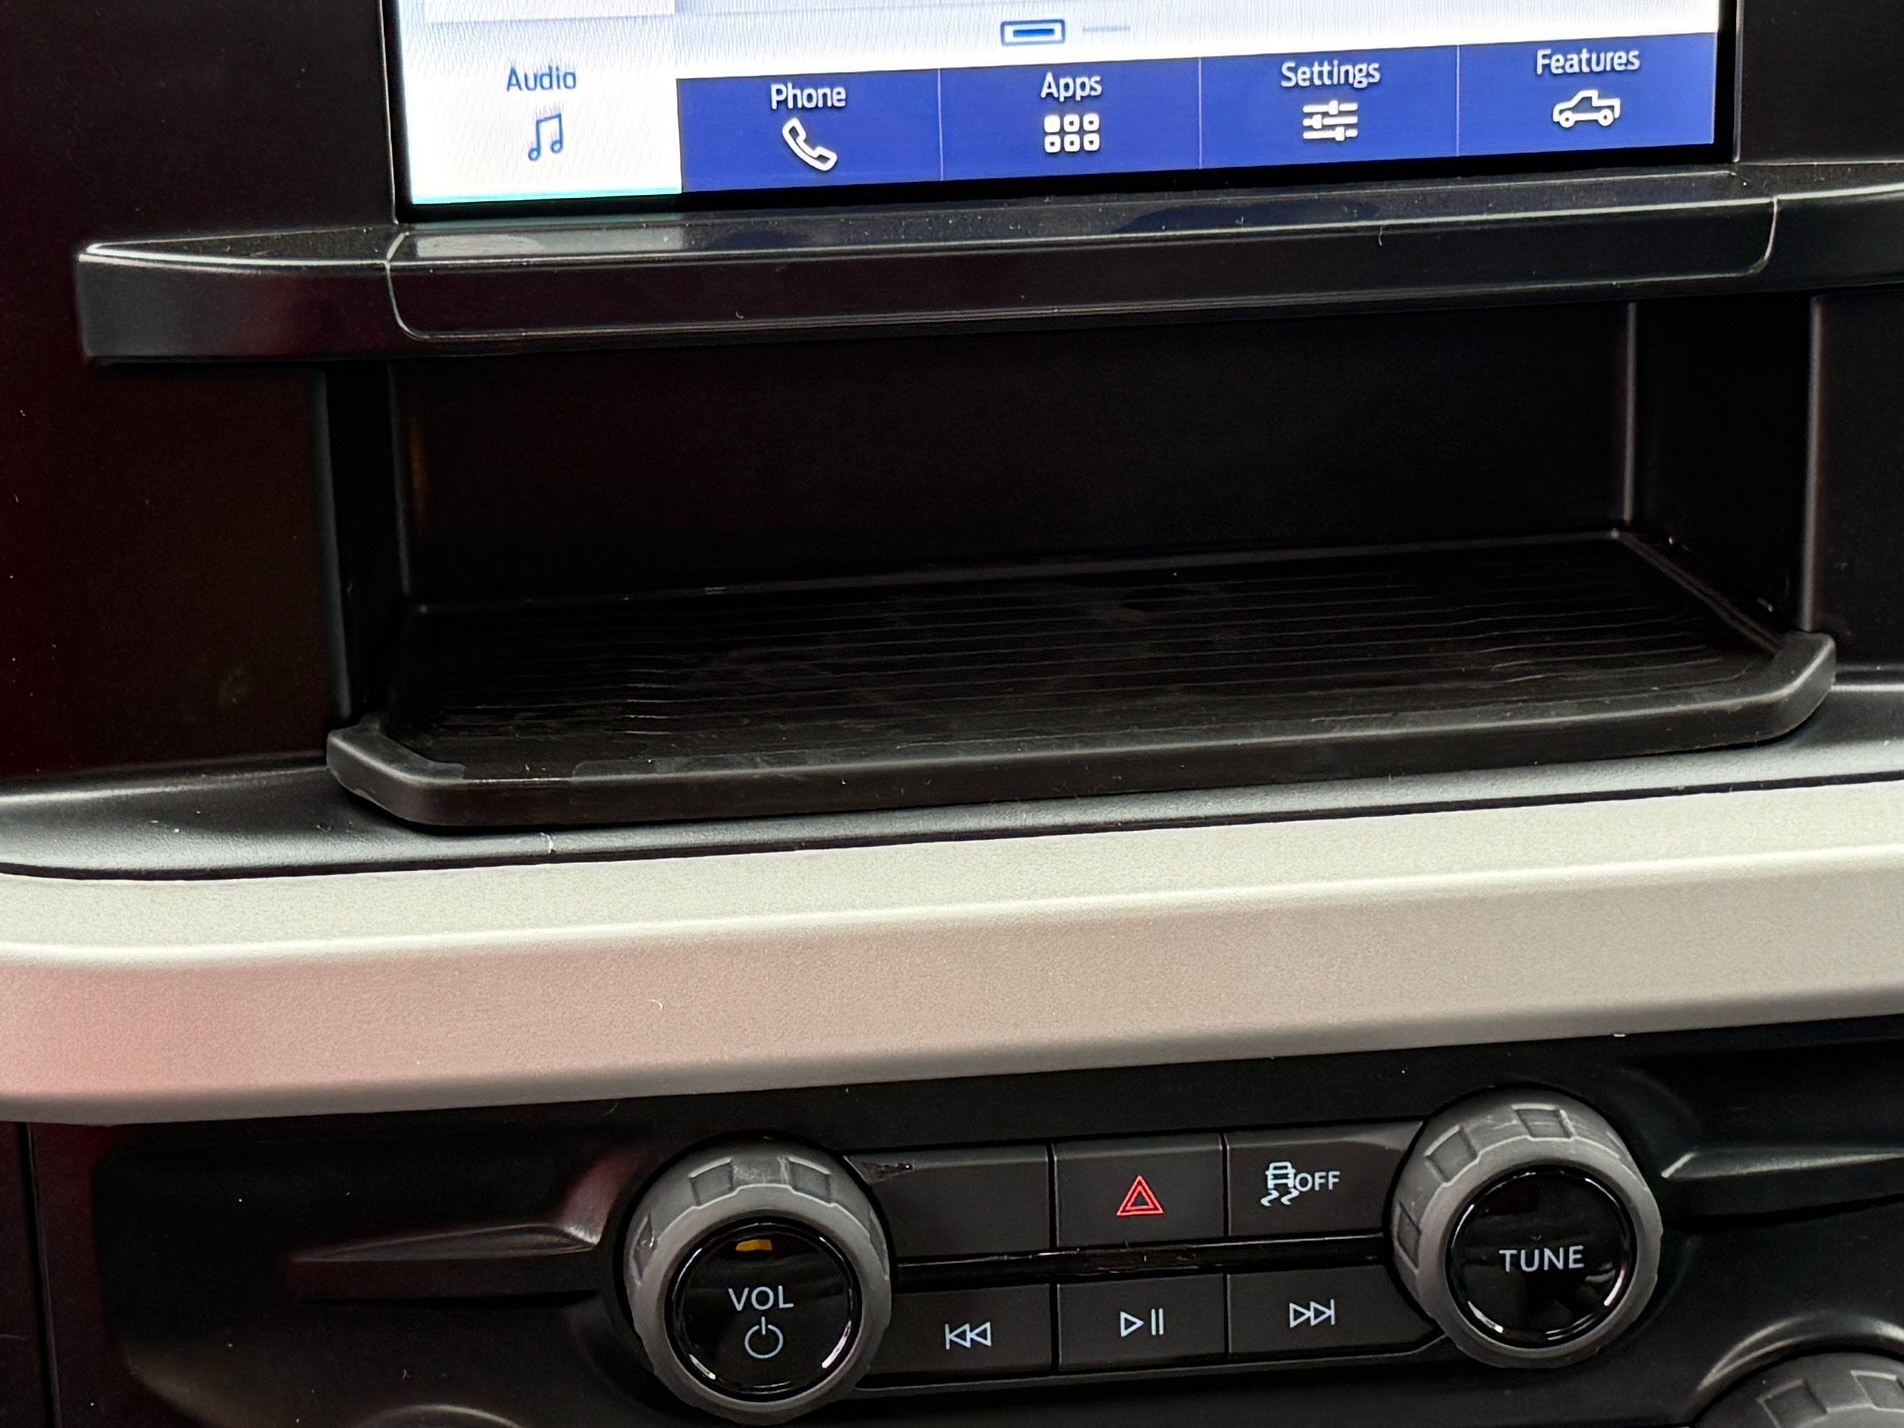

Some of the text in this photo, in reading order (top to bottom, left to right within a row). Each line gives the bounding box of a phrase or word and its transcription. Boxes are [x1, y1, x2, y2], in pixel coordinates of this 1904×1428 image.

[1280, 60, 1381, 89] Settings
[1536, 47, 1640, 75] Features
[506, 65, 578, 93] Audio
[1041, 72, 1102, 101] Apps
[770, 83, 846, 111] Phone
[1294, 1169, 1341, 1196] OFF
[1498, 1243, 1585, 1275] TUNE
[727, 1285, 795, 1313] VOL
